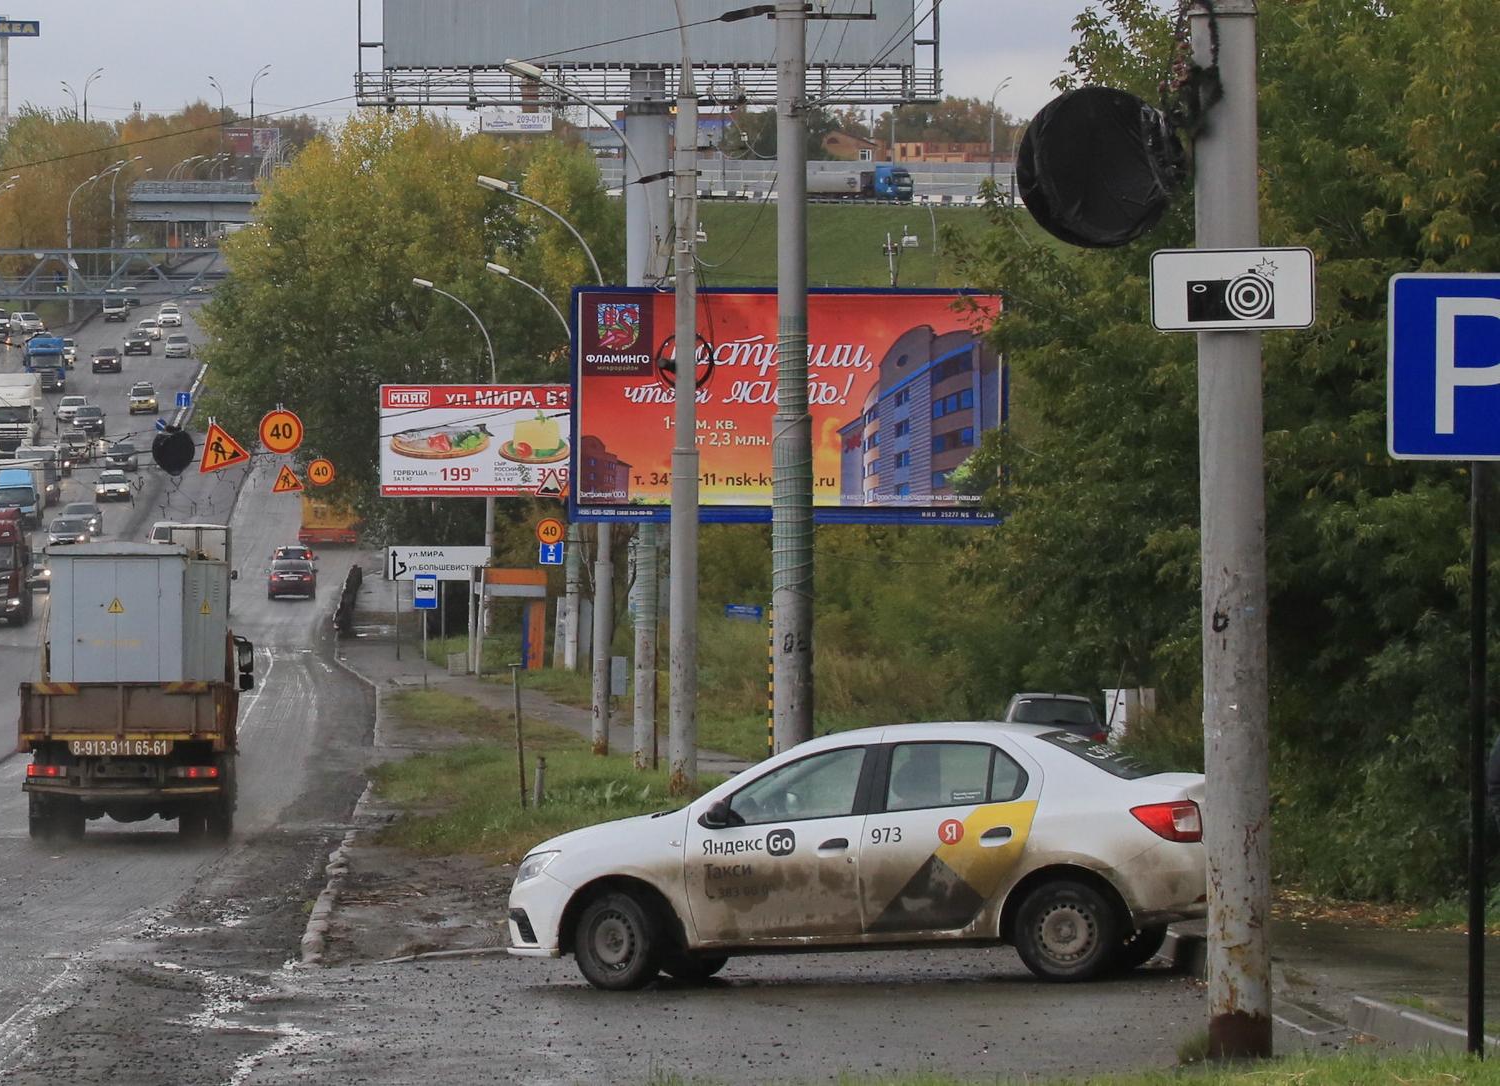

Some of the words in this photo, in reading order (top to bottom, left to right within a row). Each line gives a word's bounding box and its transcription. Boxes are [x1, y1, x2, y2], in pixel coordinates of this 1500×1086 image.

[586, 354, 650, 364] ФЛАМИНГО
[391, 394, 428, 403] МАЯК
[270, 423, 292, 439] 40
[715, 420, 738, 430] кв.
[709, 433, 731, 447] 2,3
[735, 435, 770, 446] млн.
[314, 466, 328, 476] 40
[440, 467, 471, 482] 199
[543, 526, 557, 536] 40
[73, 741, 130, 755] 8-913-911
[135, 741, 167, 755] 65-61
[872, 828, 902, 844] 973
[945, 824, 957, 841] Я
[703, 839, 763, 855] Яндекс
[768, 834, 792, 850] Go
[704, 863, 752, 880] Такси
